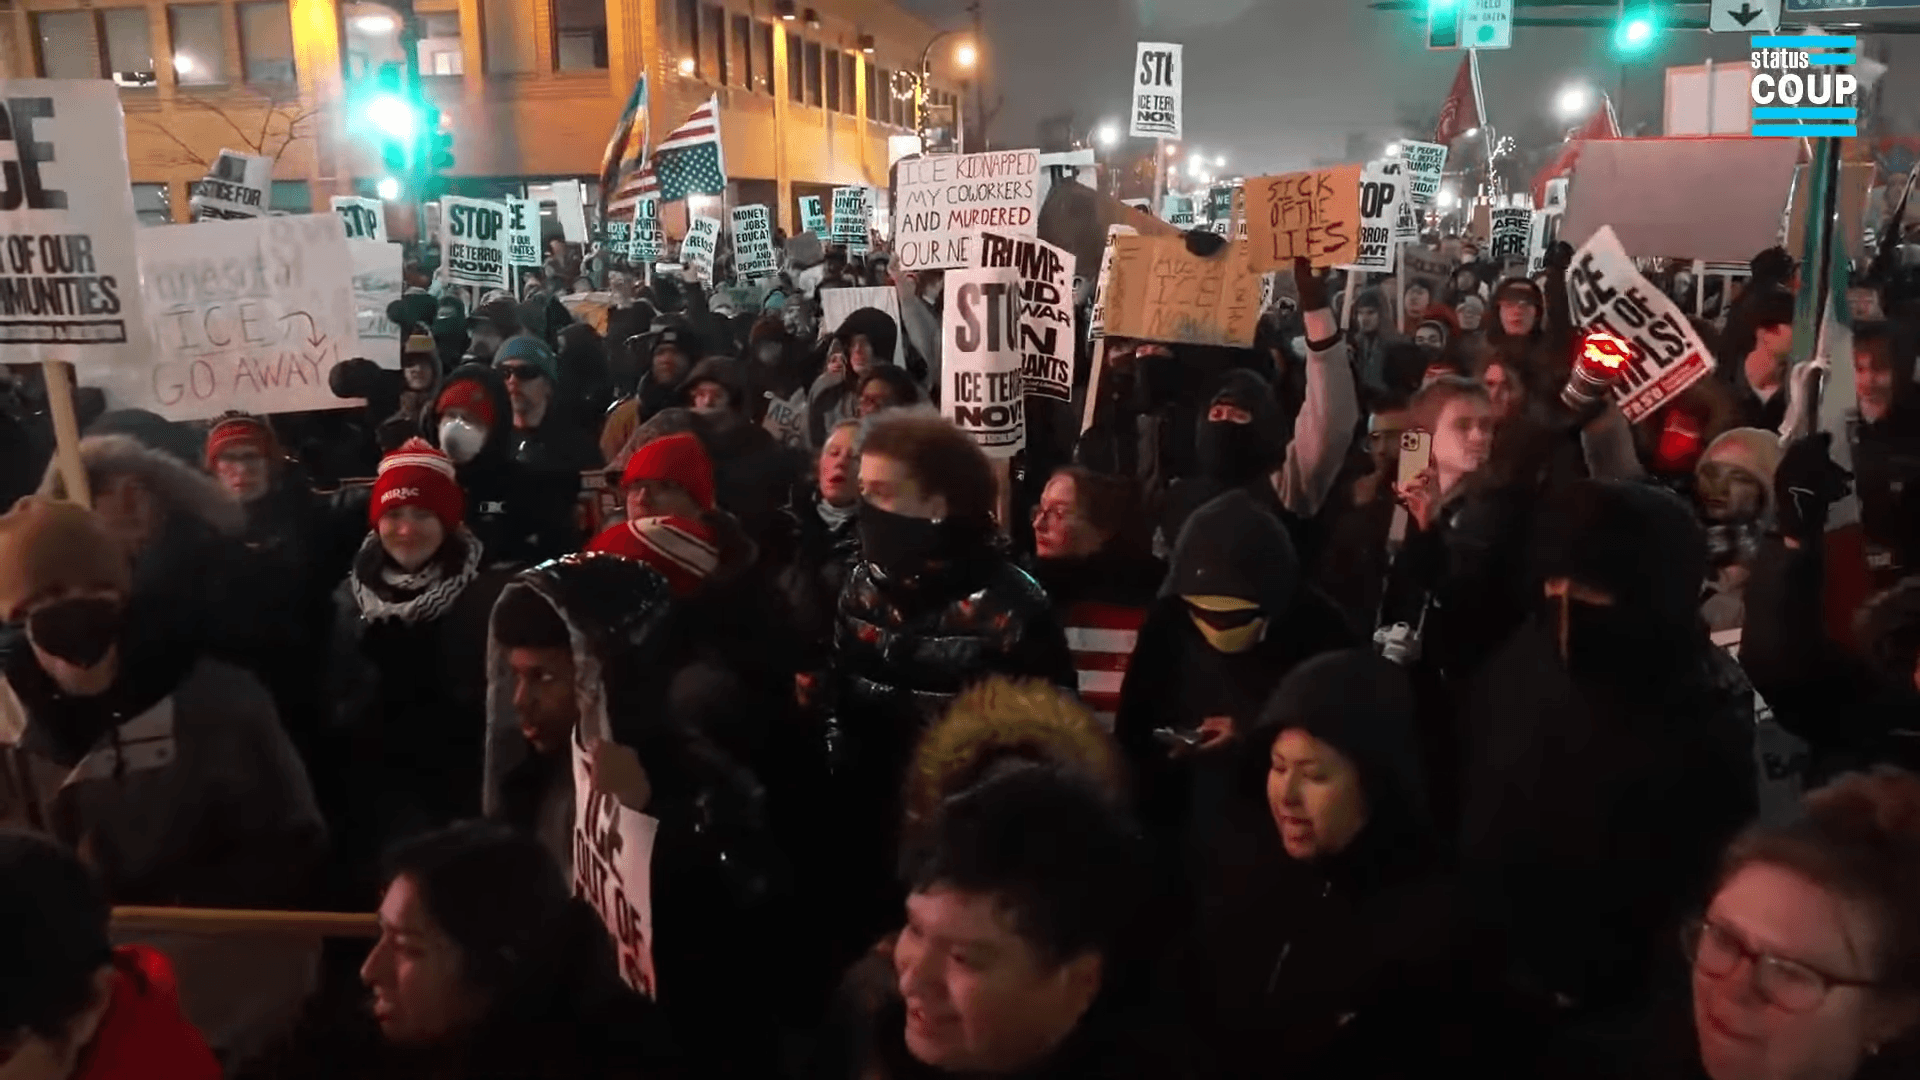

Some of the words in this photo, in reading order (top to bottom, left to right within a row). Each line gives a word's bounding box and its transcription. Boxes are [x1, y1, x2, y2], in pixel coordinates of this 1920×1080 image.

[1138, 95, 1151, 110] ICE
[900, 157, 949, 187] ICE
[956, 152, 1038, 180] KIDNAPPED
[235, 186, 262, 207] FOR
[905, 188, 942, 208] MY
[946, 180, 1034, 205] COWORKERS
[1215, 193, 1230, 206] WE
[1266, 172, 1335, 203] SICK
[732, 208, 764, 221] MONEY
[808, 198, 825, 217] IC
[901, 211, 942, 233] AND
[947, 206, 1032, 232] MURDERED
[1169, 213, 1195, 225] JUSTICE
[1270, 200, 1294, 228] OF
[1295, 197, 1330, 227] THE
[449, 203, 504, 241] STOP
[743, 218, 768, 231] JOBS
[1492, 217, 1531, 231] ARE
[449, 243, 465, 259] ICE
[737, 244, 752, 255] NOT
[901, 240, 942, 267] OUR
[947, 236, 972, 264] NE
[1273, 220, 1350, 261] LIES
[1491, 234, 1527, 257] HERE
[7, 234, 35, 275] OF
[38, 234, 97, 275] OUR
[756, 251, 772, 260] AND
[1612, 287, 1656, 329] OF
[161, 303, 267, 350] ICE
[152, 359, 216, 406] GO
[954, 371, 983, 403] ICE
